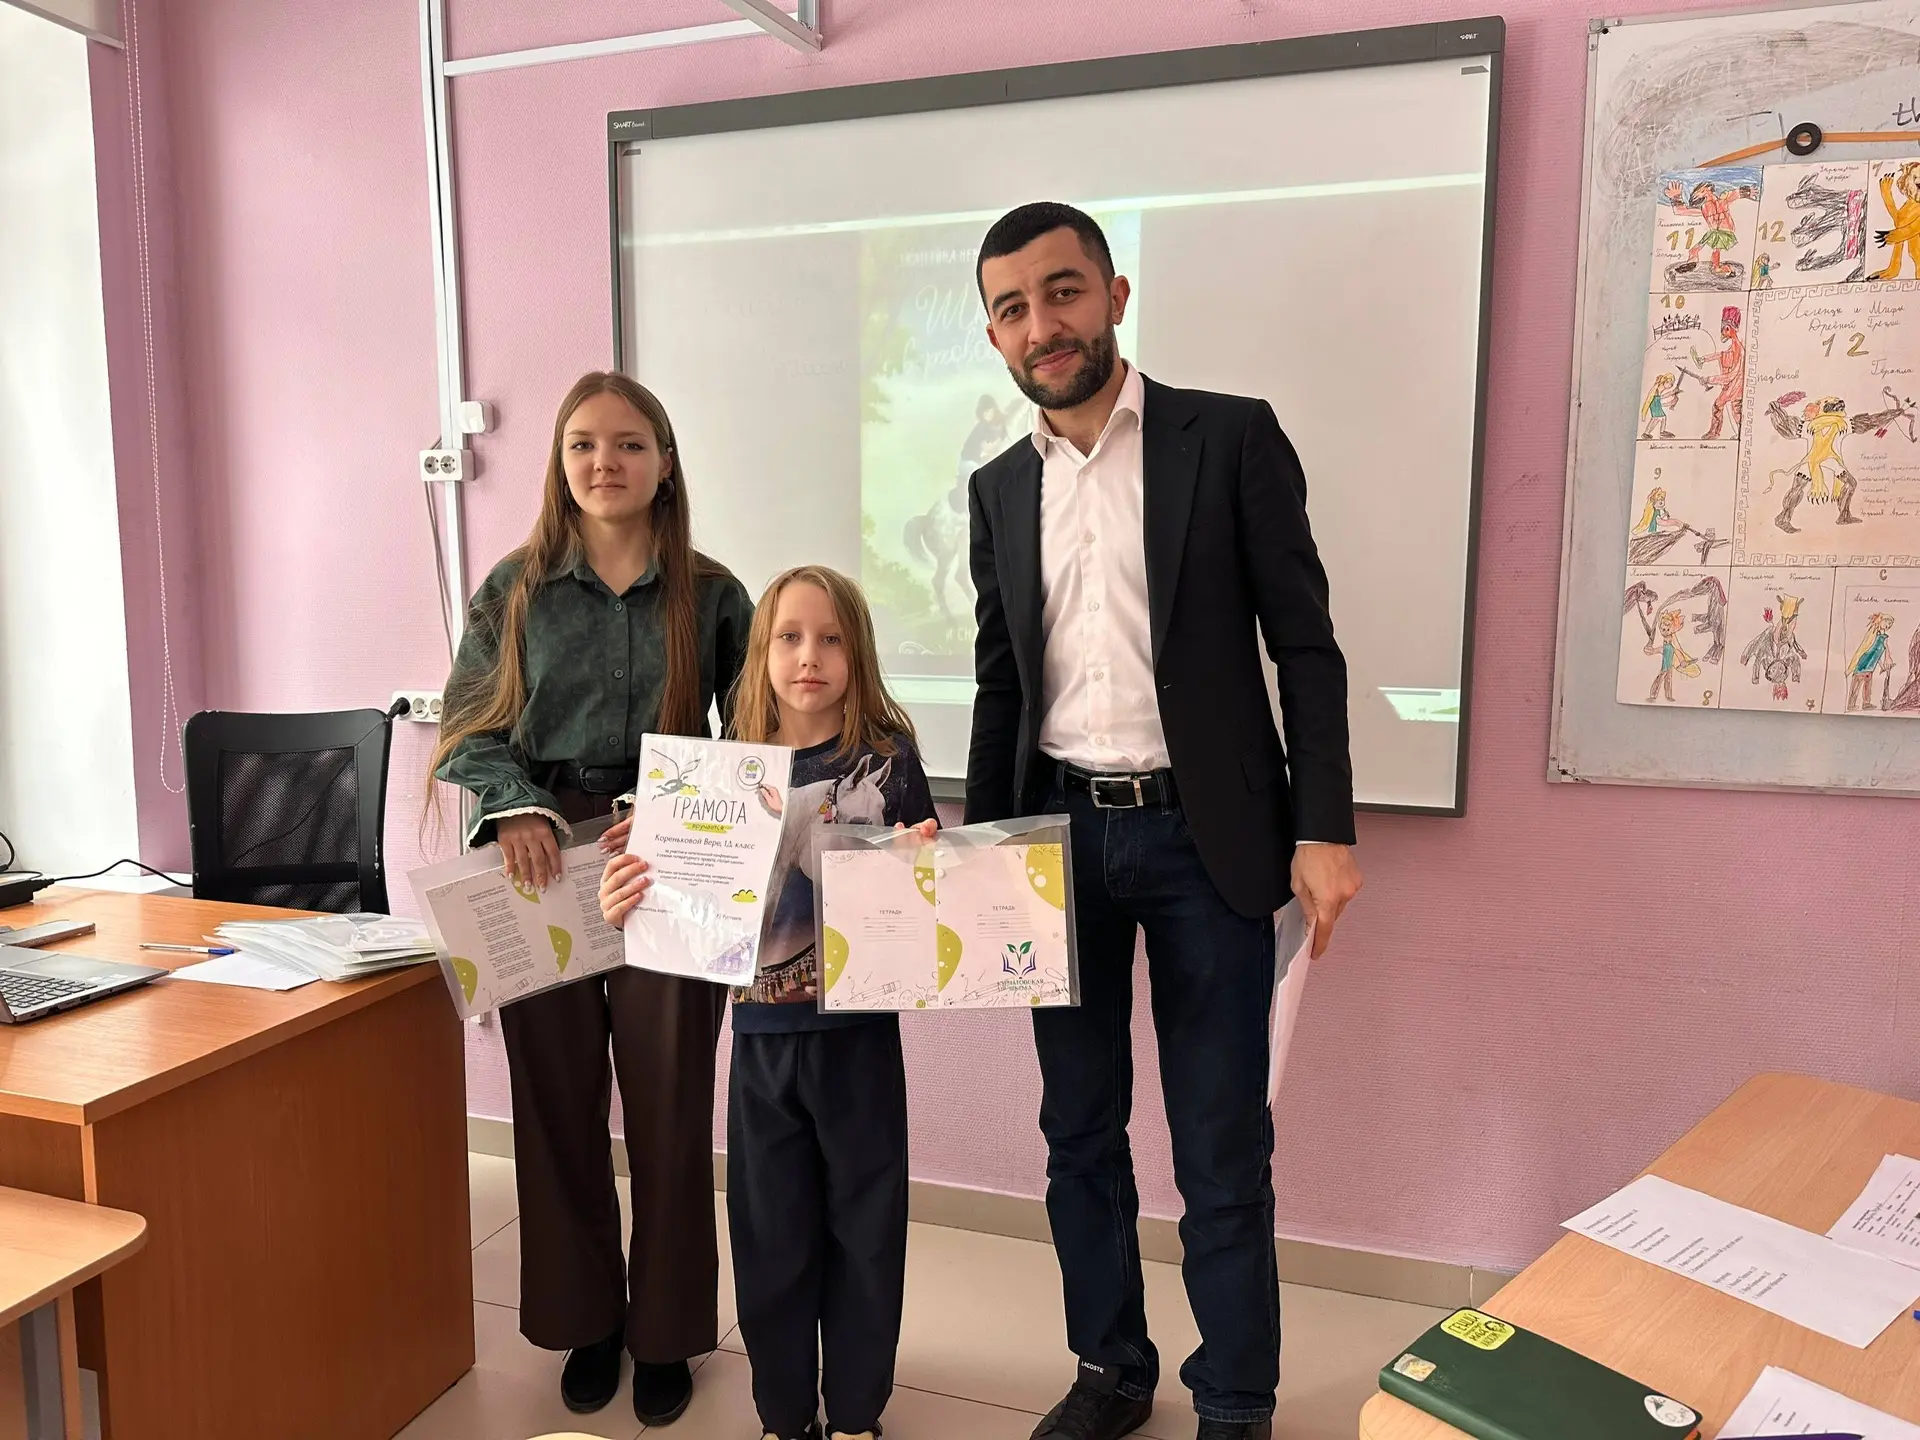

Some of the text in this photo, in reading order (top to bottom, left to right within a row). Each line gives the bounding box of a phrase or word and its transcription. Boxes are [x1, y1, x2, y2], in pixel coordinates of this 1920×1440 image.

[613, 121, 632, 130] SMART
[1666, 227, 1695, 251] 11
[1758, 220, 1786, 243] 12
[1660, 294, 1686, 309] 10
[1853, 306, 1862, 315] и
[1654, 467, 1662, 480] 9
[1702, 690, 1713, 706] 8
[672, 795, 748, 824] ГРАМОТА
[654, 833, 702, 844] Кореньковой
[735, 842, 755, 850] класс
[1081, 1360, 1104, 1374] LACOSTE
